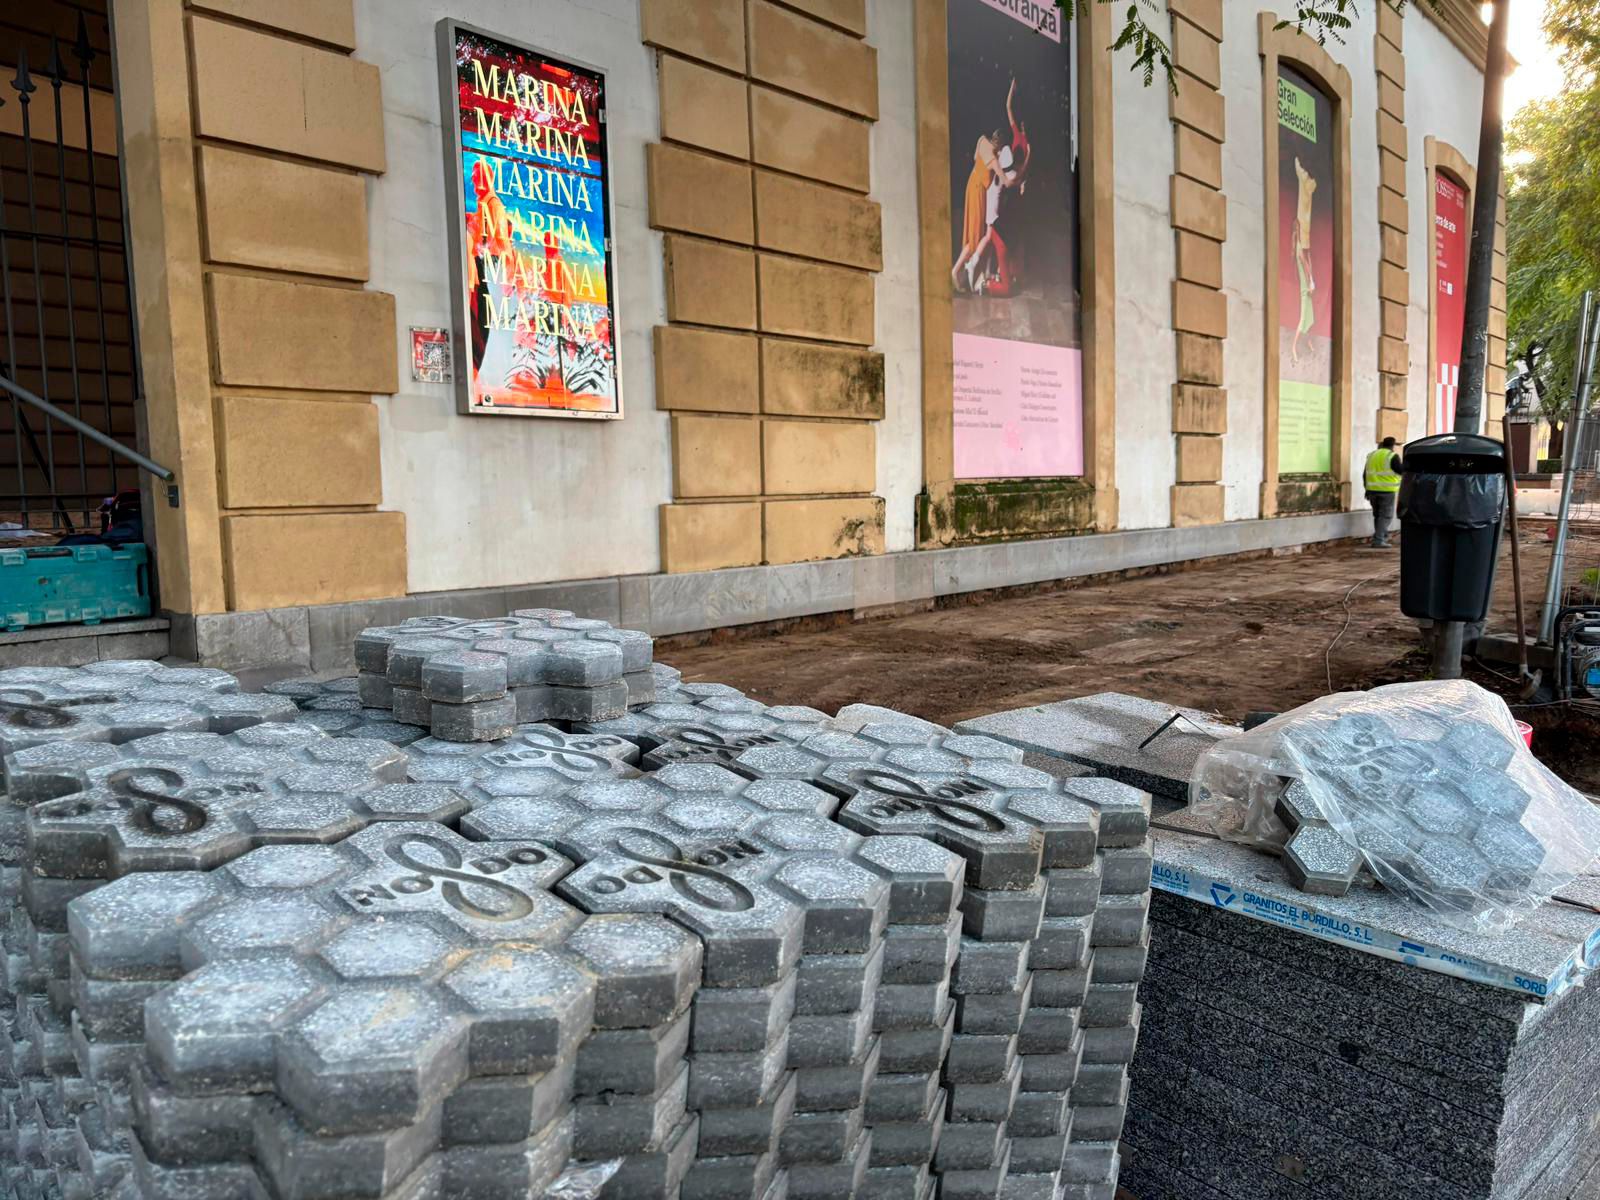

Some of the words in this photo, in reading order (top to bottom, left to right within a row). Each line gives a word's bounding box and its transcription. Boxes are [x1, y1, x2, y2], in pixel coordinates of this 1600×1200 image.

[472, 58, 590, 126] MARINA
[1278, 79, 1297, 107] Gran
[474, 106, 591, 169] MARINA
[478, 156, 593, 212] MARINA
[480, 201, 597, 255] MARINA
[482, 248, 596, 298] MARINA
[483, 293, 598, 341] MARINA
[1243, 892, 1288, 914] GRANITOS
[1288, 906, 1300, 918] EL
